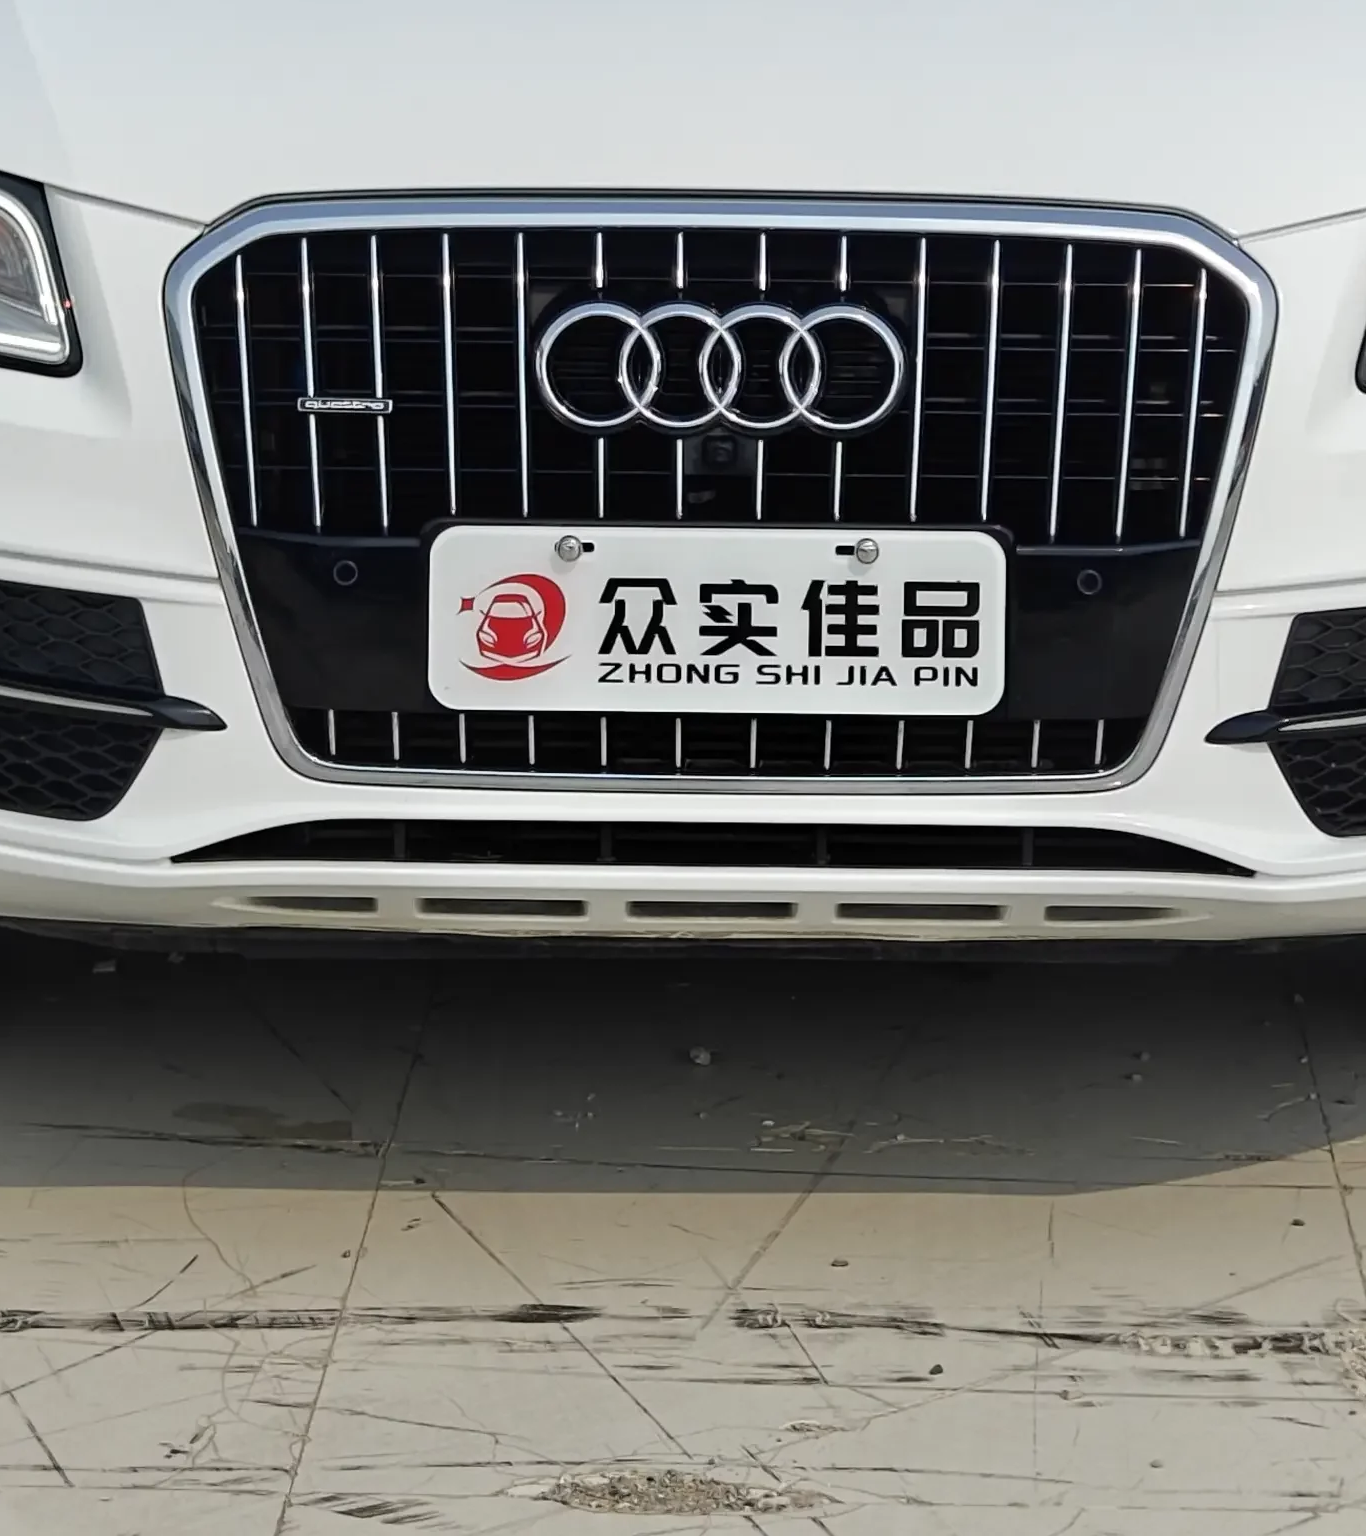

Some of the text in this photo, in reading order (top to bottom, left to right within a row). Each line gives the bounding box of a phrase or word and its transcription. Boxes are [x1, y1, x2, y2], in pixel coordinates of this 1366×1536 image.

[597, 577, 982, 658] 众实佳品
[597, 662, 980, 688] ZHONG SHI JIA PIN
